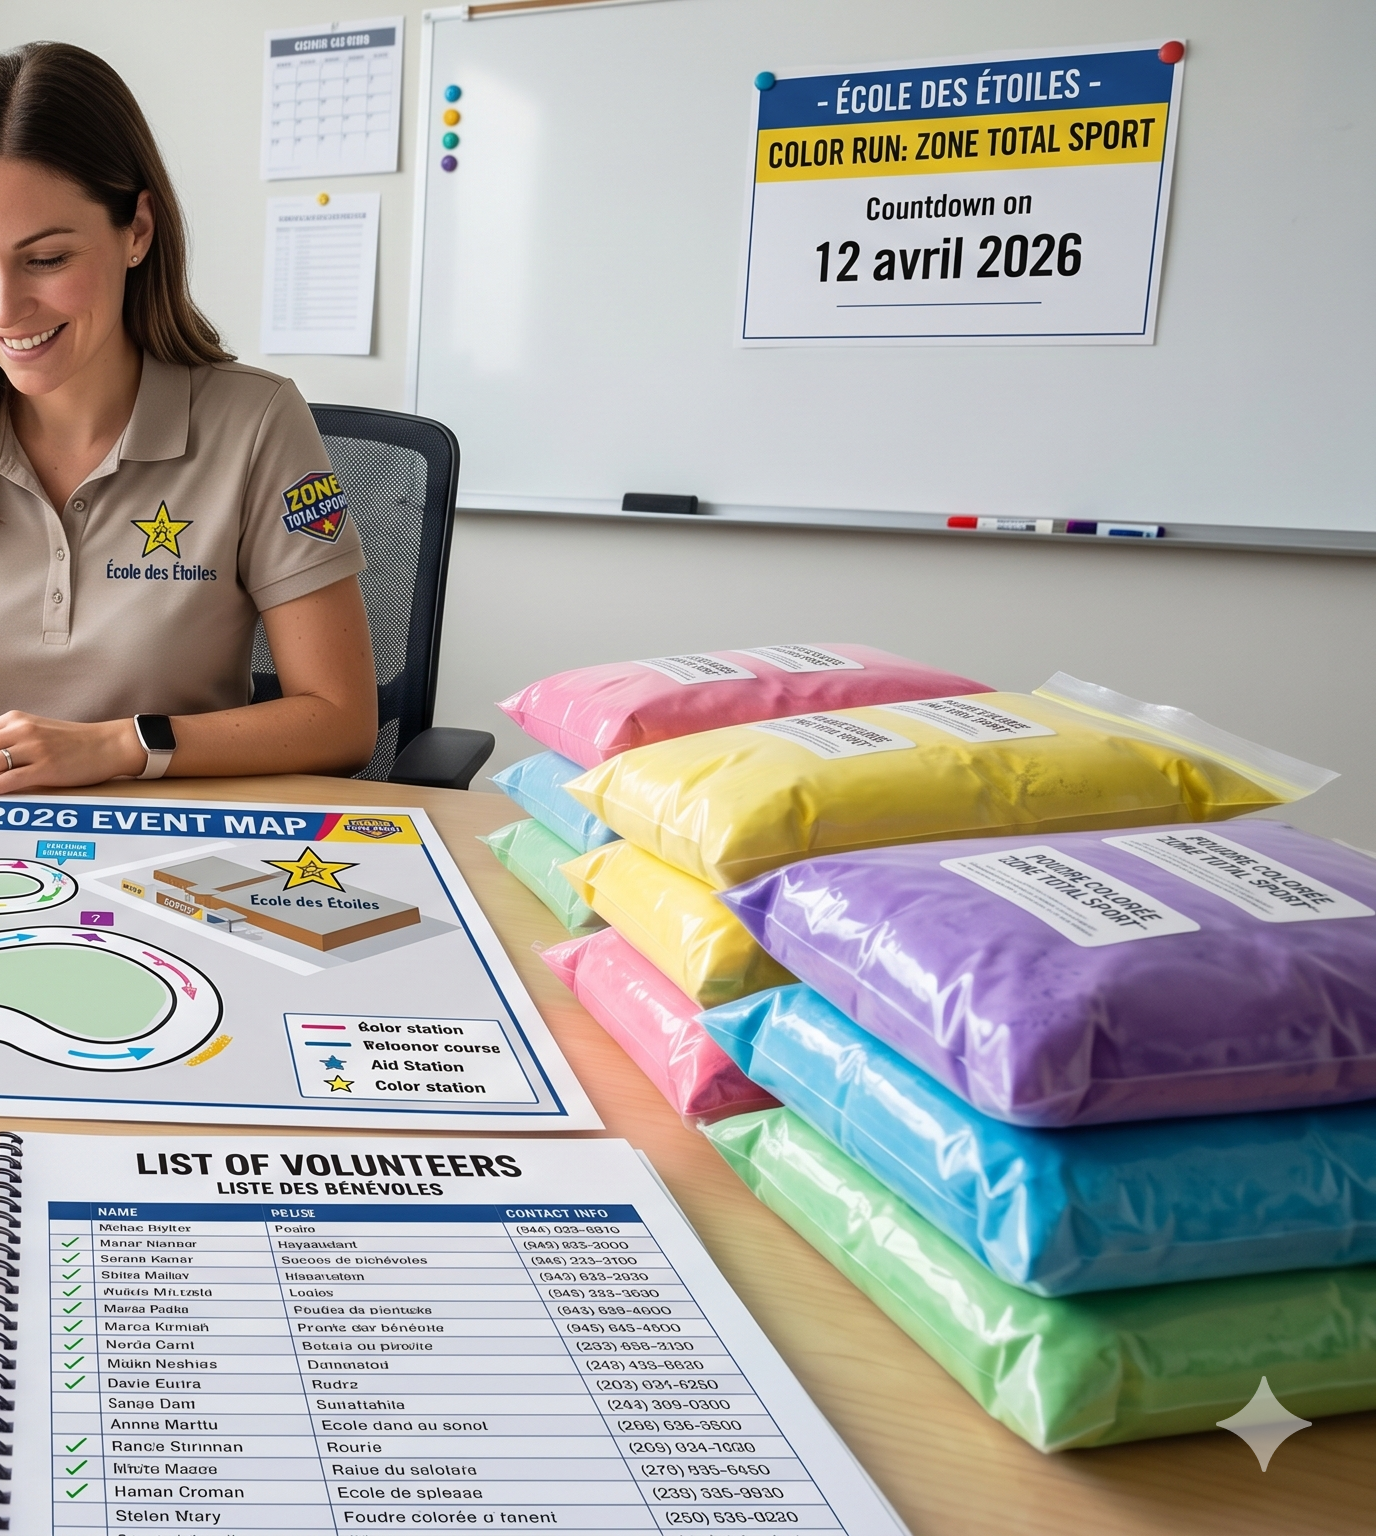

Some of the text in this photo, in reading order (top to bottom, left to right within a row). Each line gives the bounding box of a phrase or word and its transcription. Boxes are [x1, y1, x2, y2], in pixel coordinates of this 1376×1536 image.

[836, 69, 1082, 115] ÉCOLE DES ÉTOILES
[769, 118, 1156, 169] COLOR RUN: ZONE TOTAL SPORT
[866, 193, 1032, 221] Countdown on
[816, 232, 1082, 282] 12 avril 2026
[286, 473, 342, 512] ZONE
[286, 506, 320, 530] TOTAL
[106, 559, 217, 581] École des Étoiles
[92, 811, 212, 833] EVENT
[223, 814, 308, 836] MAP
[299, 895, 323, 908] des
[407, 1024, 464, 1035] station
[444, 1043, 501, 1054] course
[371, 1059, 464, 1072] Aid Station
[375, 1080, 486, 1093] Color station
[136, 1153, 522, 1178] LIST OF VOLUNTEERS
[217, 1179, 444, 1197] LISTE DES BÉNÉVOLES
[98, 1207, 609, 1219] NAME CONTACT INFO
[108, 1378, 150, 1389] Davie
[114, 1485, 173, 1498] Haman
[179, 1486, 245, 1498] Croman
[391, 1487, 411, 1499] de
[344, 1511, 406, 1523] Foudre
[411, 1510, 477, 1523] colorée
